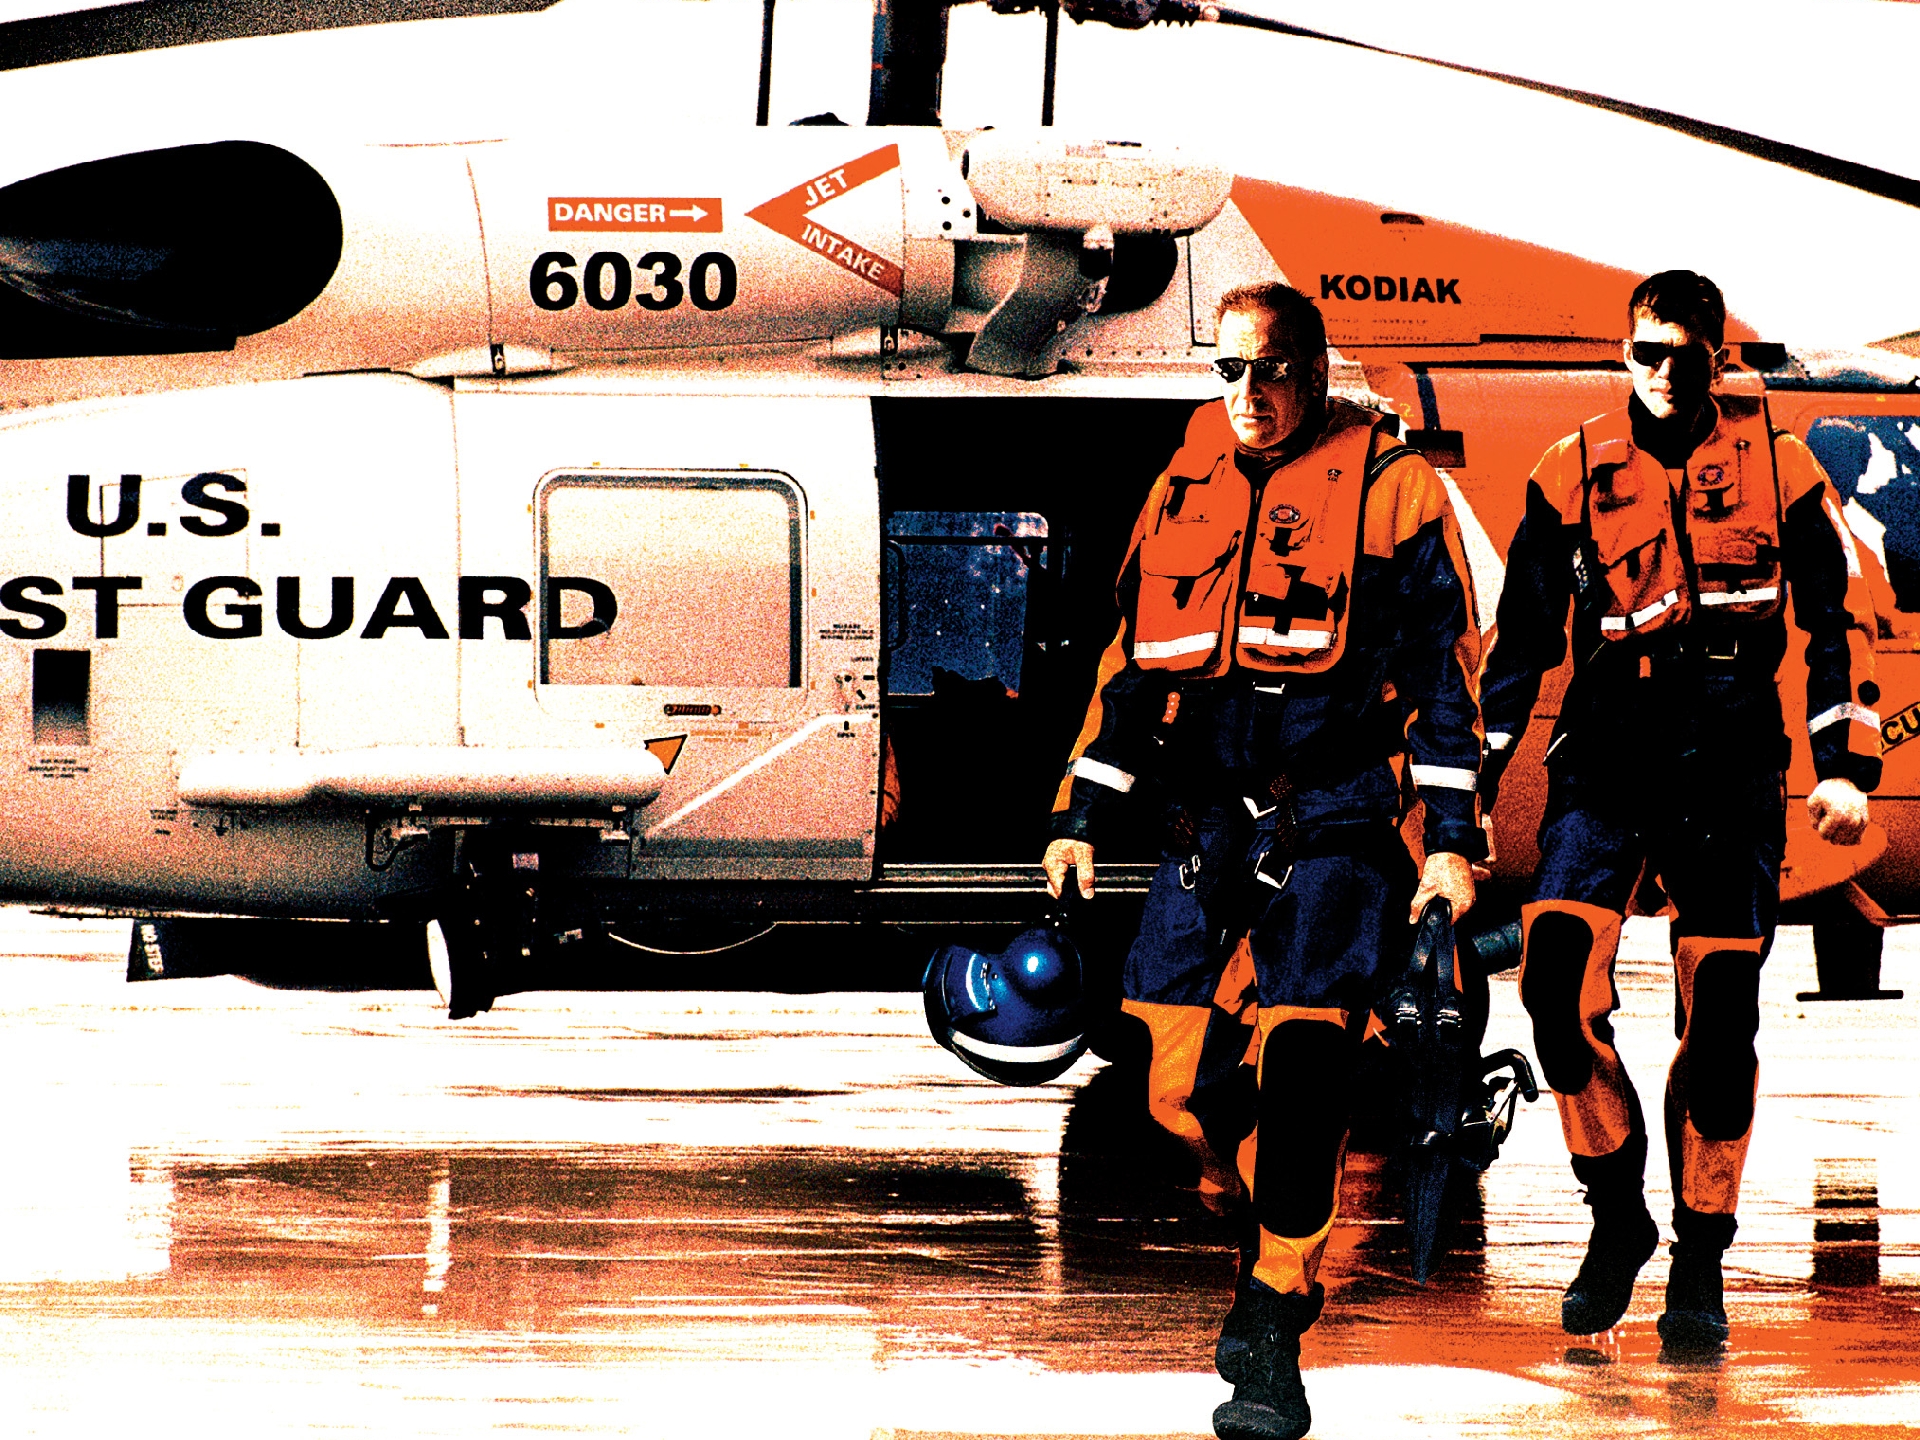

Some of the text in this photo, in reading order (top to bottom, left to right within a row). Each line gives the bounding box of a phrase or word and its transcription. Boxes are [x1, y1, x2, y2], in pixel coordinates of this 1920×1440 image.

[554, 203, 666, 223] DANGER
[805, 169, 848, 207] JET
[801, 223, 884, 281] INTAKE
[529, 251, 738, 312] 6030
[1320, 274, 1462, 305] KODIAK
[66, 472, 281, 538] U.S.
[0, 575, 618, 640] ST GUARD
[1880, 707, 1920, 751] CU
